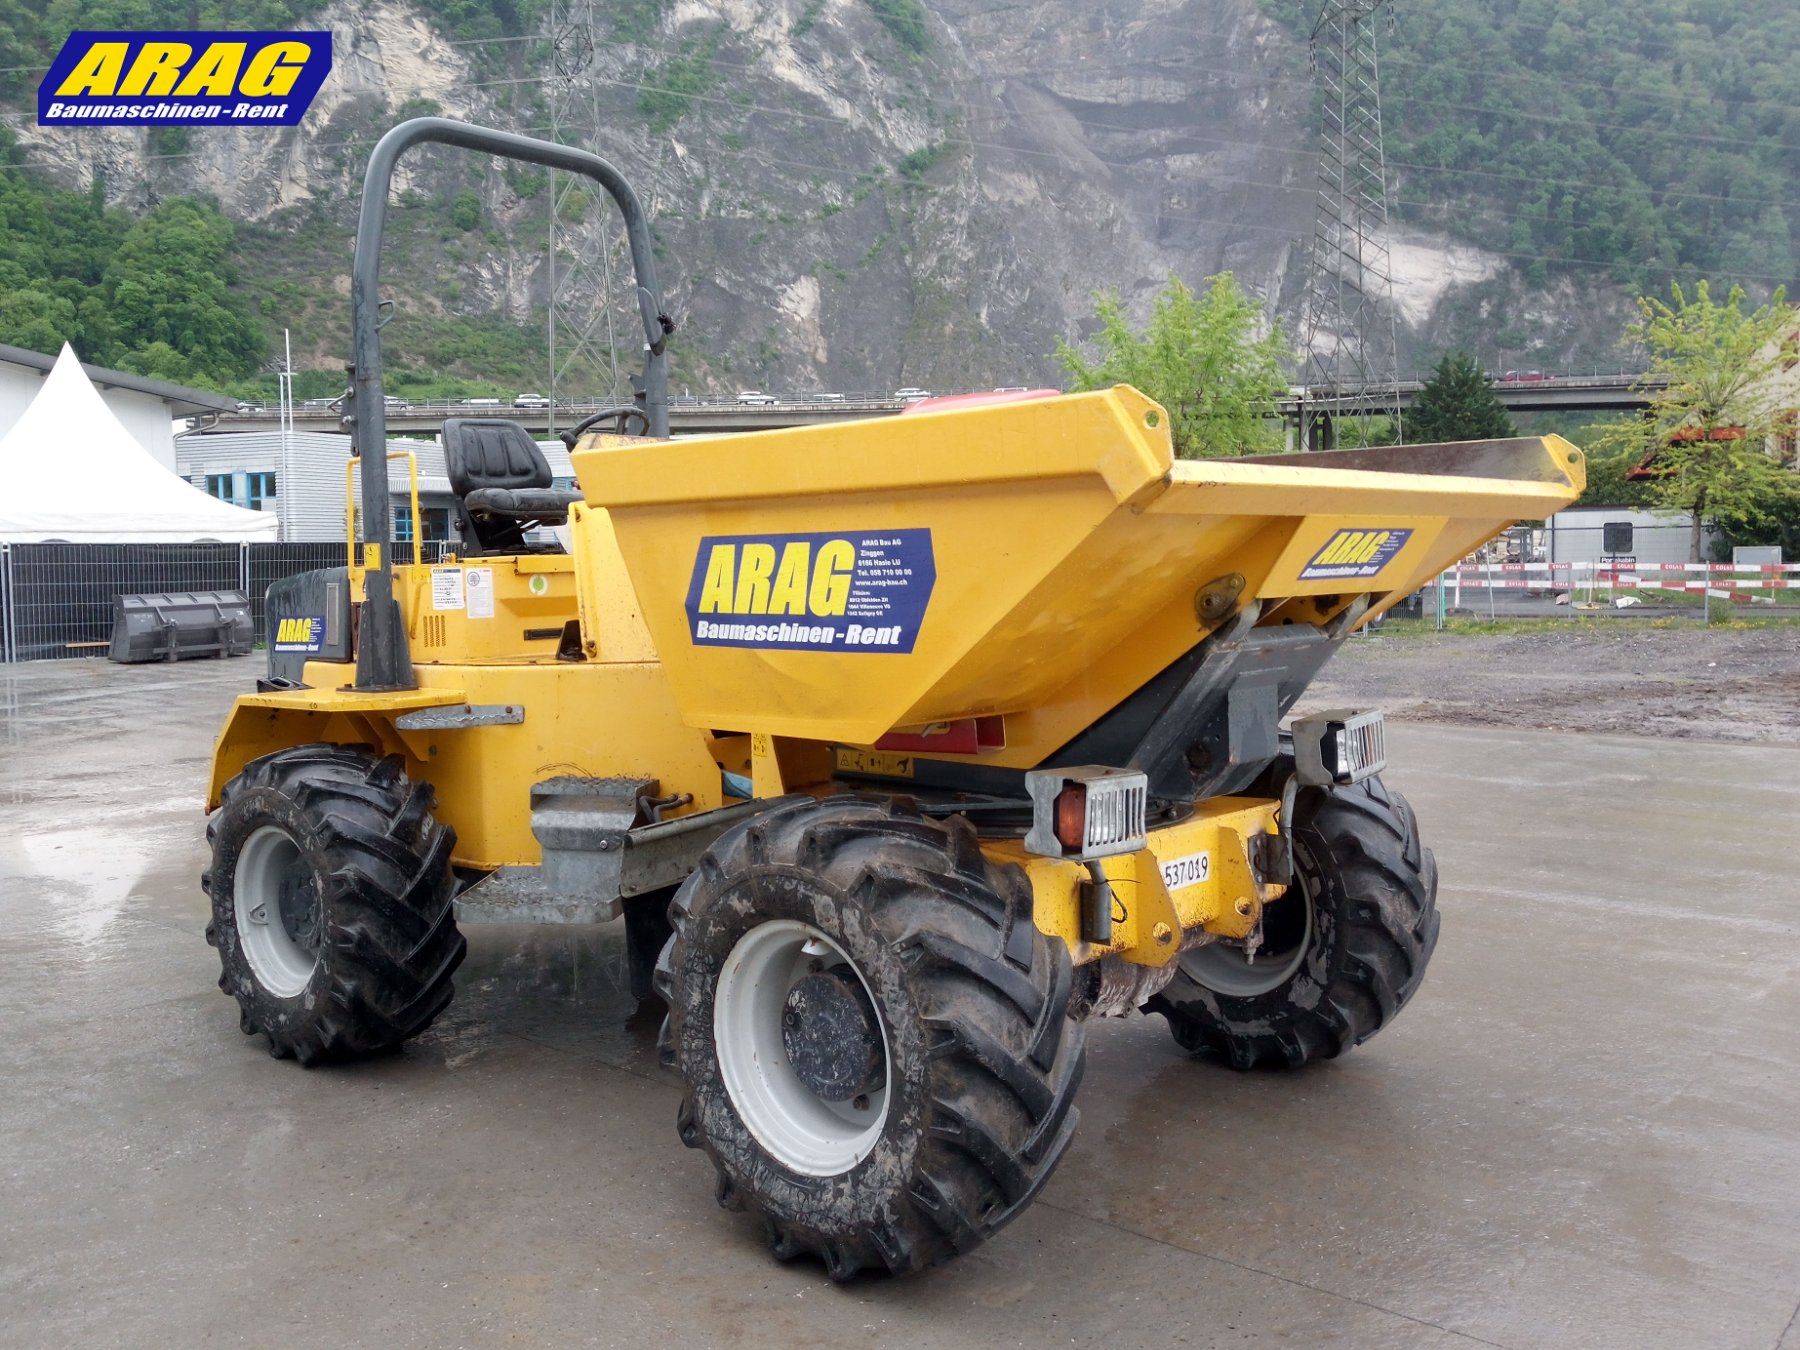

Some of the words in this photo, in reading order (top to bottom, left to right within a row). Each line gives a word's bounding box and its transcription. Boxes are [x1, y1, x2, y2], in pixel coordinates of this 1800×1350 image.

[861, 539, 879, 547] ARAG
[892, 538, 902, 546] AG
[1312, 531, 1390, 565] ARAG
[891, 558, 901, 566] LU
[698, 539, 856, 617] ARAG
[276, 618, 312, 643] ARAG
